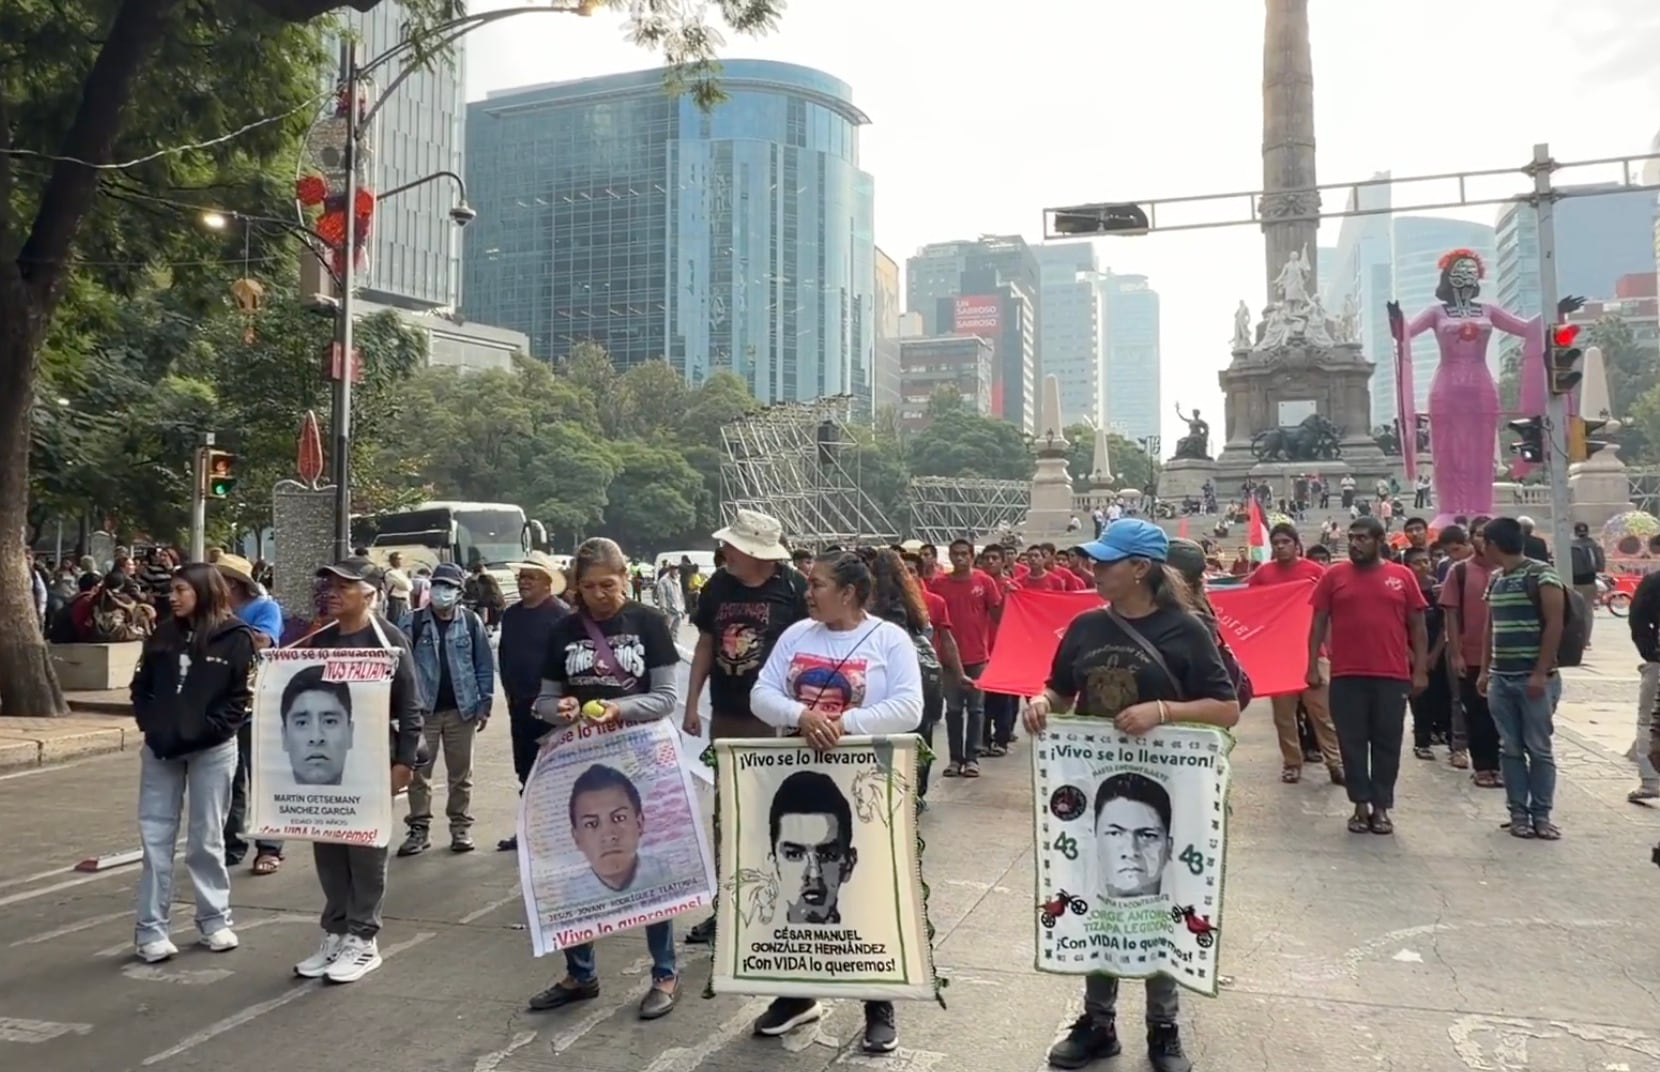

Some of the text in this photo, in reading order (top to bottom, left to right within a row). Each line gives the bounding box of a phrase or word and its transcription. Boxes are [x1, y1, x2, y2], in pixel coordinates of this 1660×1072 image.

[301, 649, 316, 660] se
[319, 649, 330, 660] lo
[577, 724, 592, 740] lo
[741, 749, 876, 769] ¡Vivo se lo llevaron
[1051, 745, 1215, 769] ¡Vivo se lo llevaron!
[307, 795, 361, 804] GETSEMANY
[279, 805, 357, 816] SÁNCHEZ GARCÍA
[1053, 831, 1080, 860] 43
[1179, 843, 1205, 875] 43
[773, 926, 862, 941] CÉSAR MANUEL
[1083, 921, 1121, 933] TIZAPA
[552, 928, 593, 950] ¡Vivo
[1056, 936, 1087, 951] ¡Con
[1089, 934, 1120, 950] VIDA
[1123, 936, 1137, 950] lo
[751, 940, 887, 955] GONZÁLEZ HERNÁNDEZ
[743, 956, 896, 976] ¡Con VIDA lo queremos!
